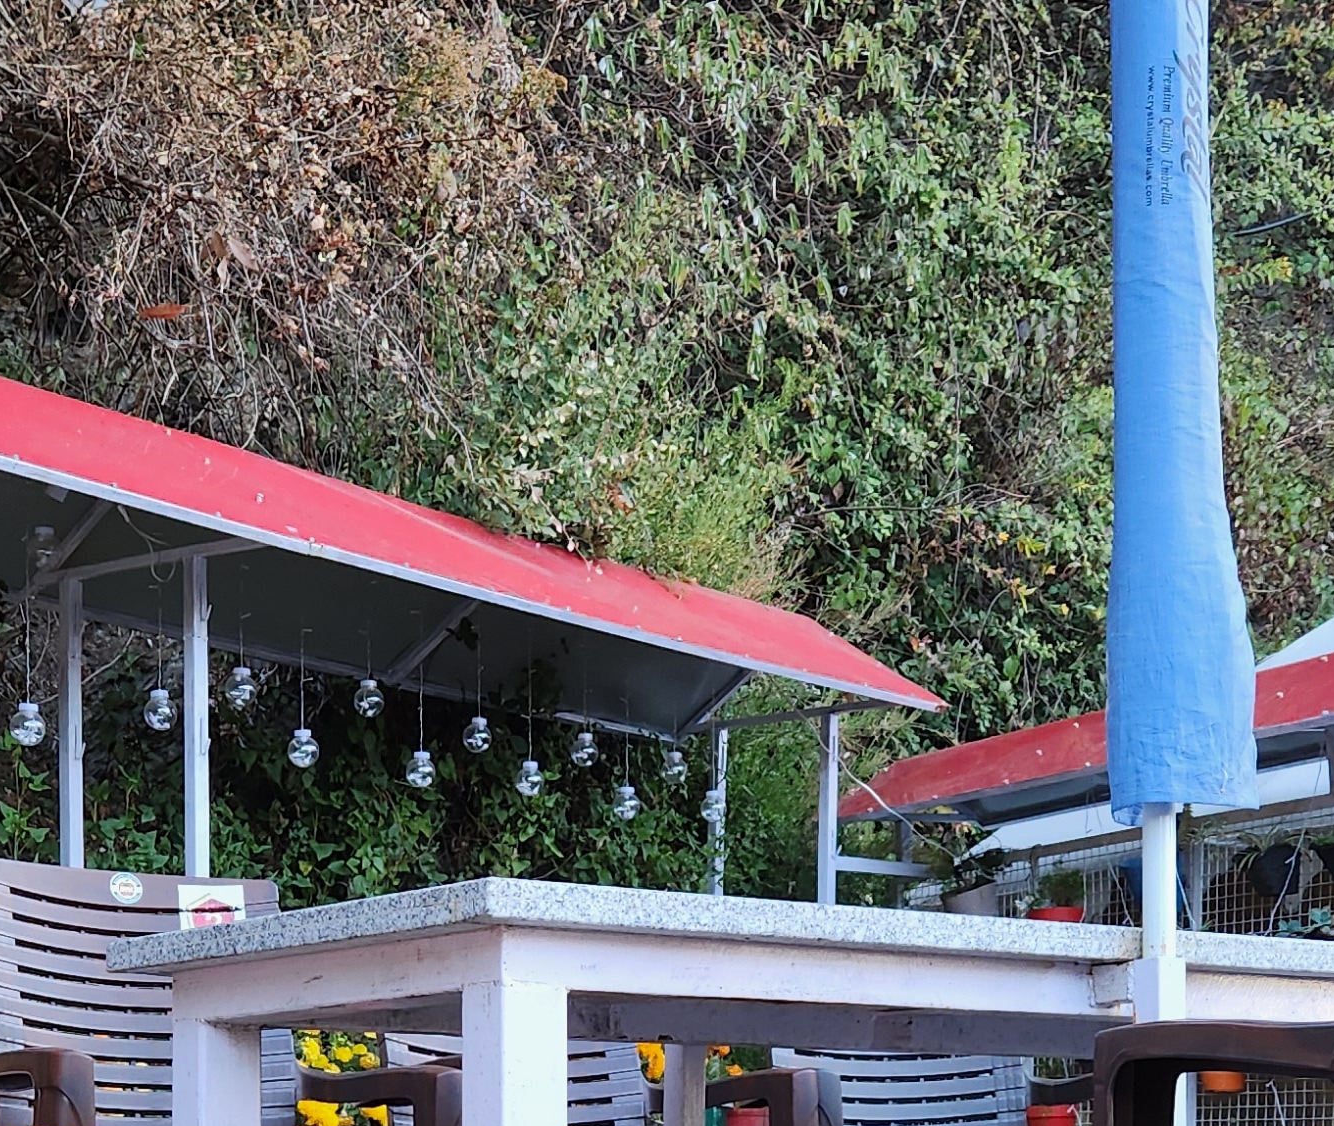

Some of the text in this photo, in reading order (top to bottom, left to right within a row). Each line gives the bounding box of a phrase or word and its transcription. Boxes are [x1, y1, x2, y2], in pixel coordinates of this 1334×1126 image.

[1145, 66, 1156, 207] www.crystalumbrellas.com
[1158, 65, 1175, 206] Premium Quality Umbrella
[1173, 0, 1208, 205] Crystal
